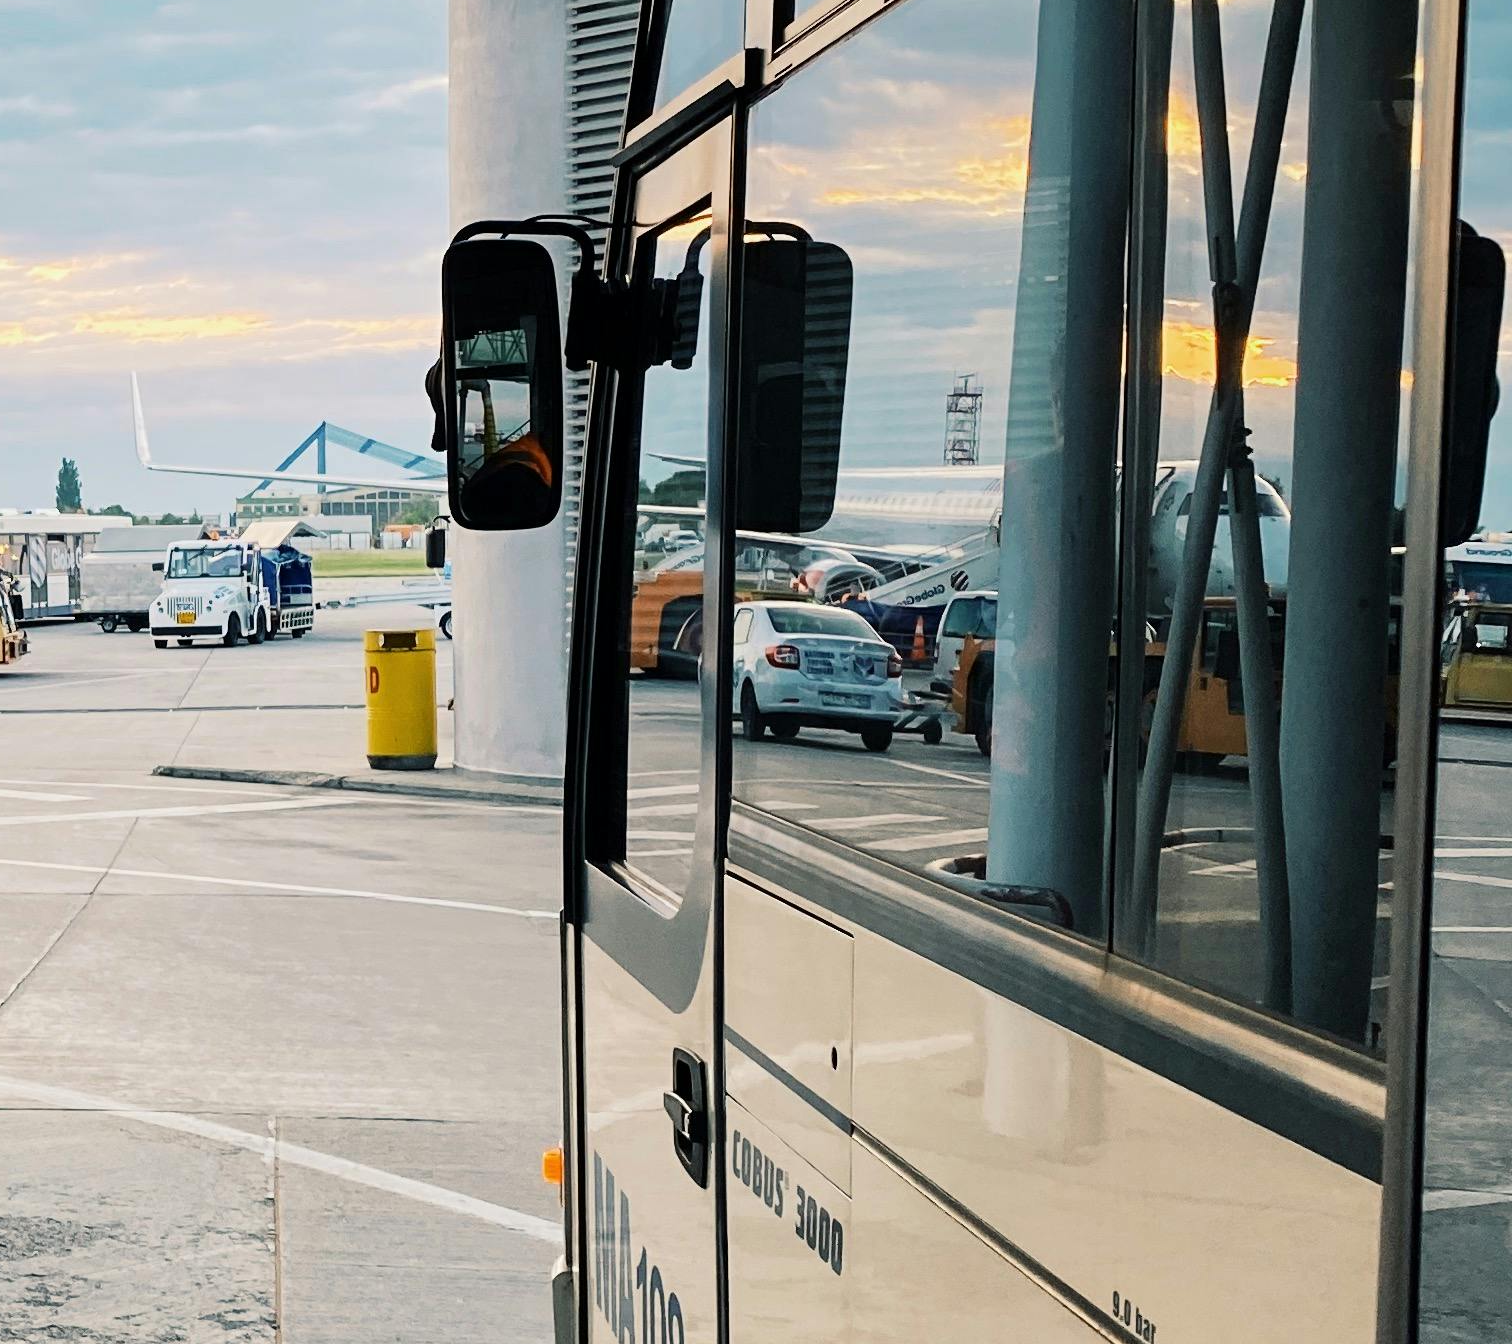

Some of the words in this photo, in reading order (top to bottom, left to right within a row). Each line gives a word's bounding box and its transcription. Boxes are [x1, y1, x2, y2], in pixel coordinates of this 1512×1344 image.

[732, 1129, 784, 1218] COBUS
[795, 1185, 844, 1276] 3000
[1112, 1290, 1132, 1327] 9.0
